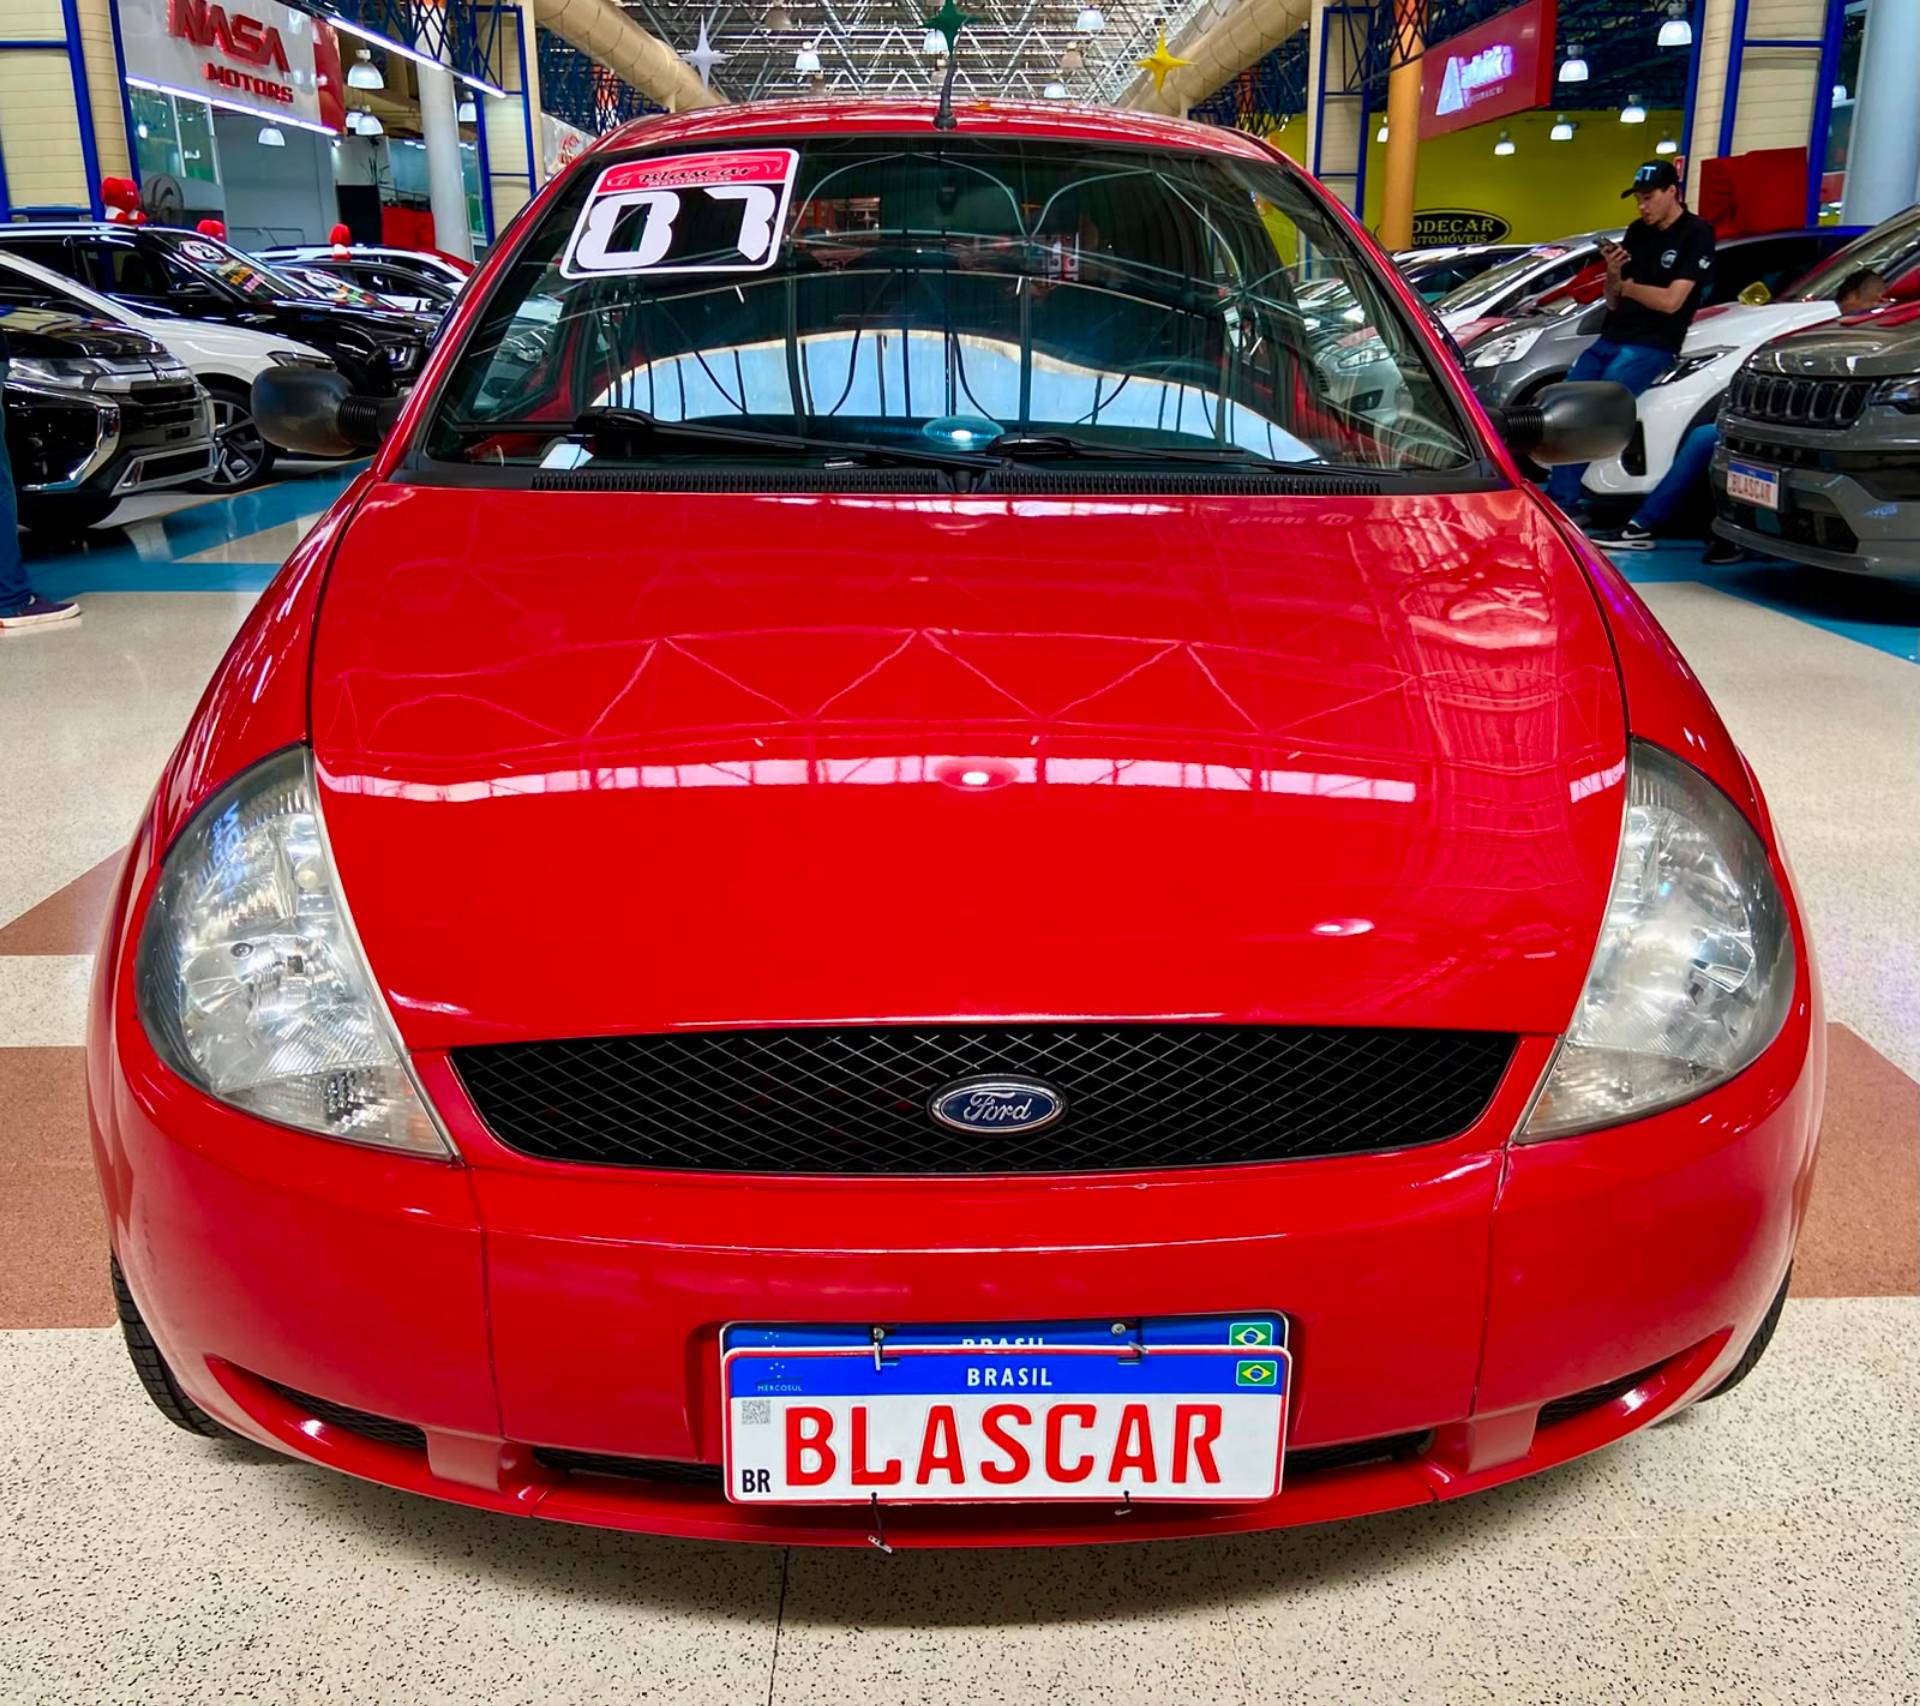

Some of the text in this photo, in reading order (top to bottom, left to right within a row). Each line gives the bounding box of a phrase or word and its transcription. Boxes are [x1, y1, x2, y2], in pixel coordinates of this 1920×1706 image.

[169, 0, 290, 73] NASA
[205, 63, 294, 104] MOTORS
[575, 185, 776, 270] 07
[1411, 218, 1494, 234] ODECAR
[1412, 232, 1488, 245] UTOMÓVEIS
[963, 1091, 1032, 1121] Ford
[967, 1367, 1053, 1387] BRASIL
[785, 1403, 1222, 1486] BLASCAR
[741, 1469, 771, 1494] BR
